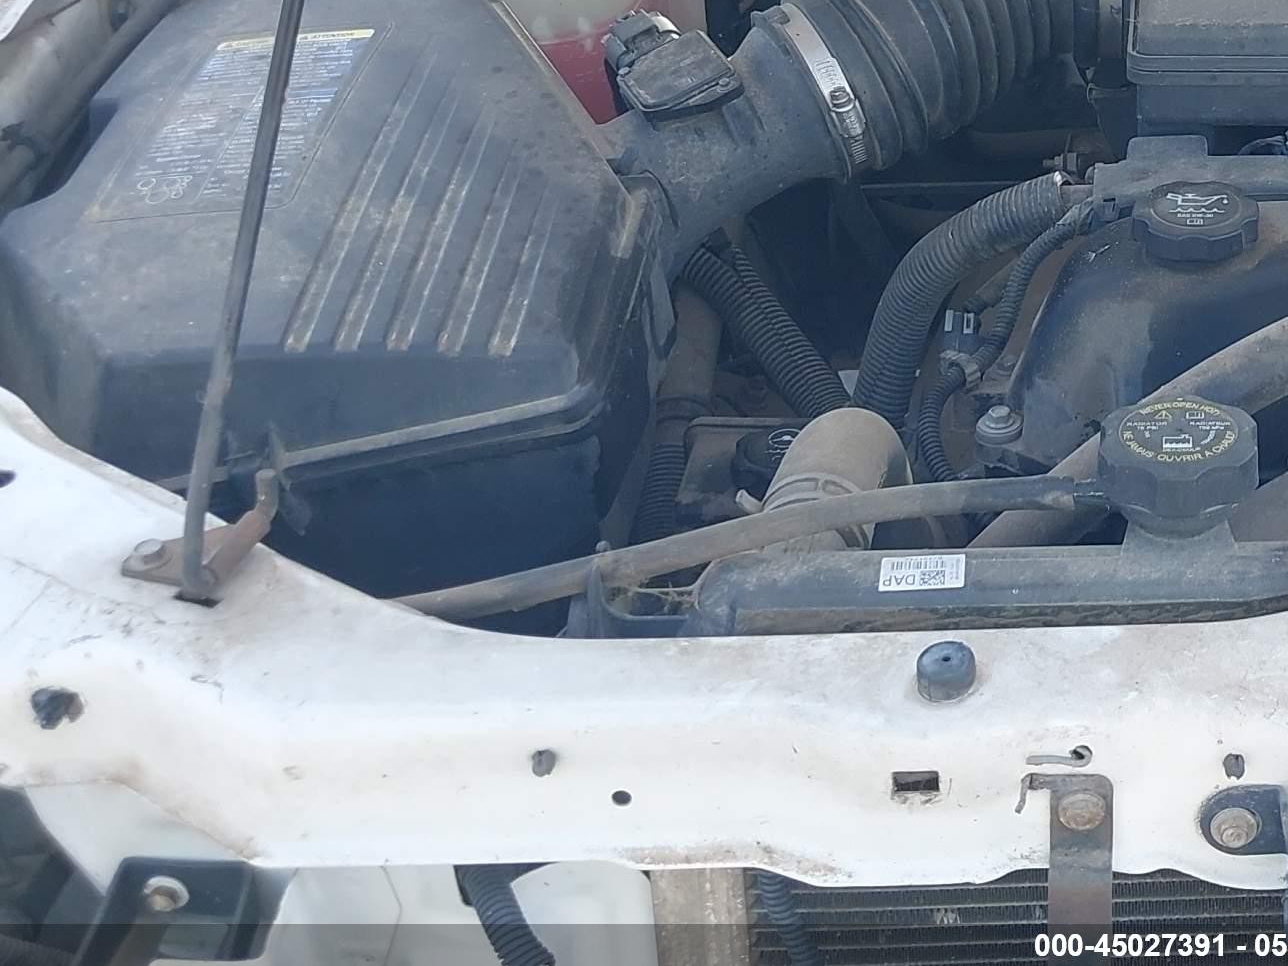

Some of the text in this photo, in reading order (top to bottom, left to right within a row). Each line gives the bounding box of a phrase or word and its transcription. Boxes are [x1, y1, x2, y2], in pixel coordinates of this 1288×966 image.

[1139, 402, 1171, 416] NEVER
[1172, 401, 1201, 410] OPEN
[1156, 452, 1203, 463] OUVRIR
[882, 574, 916, 587] DAP
